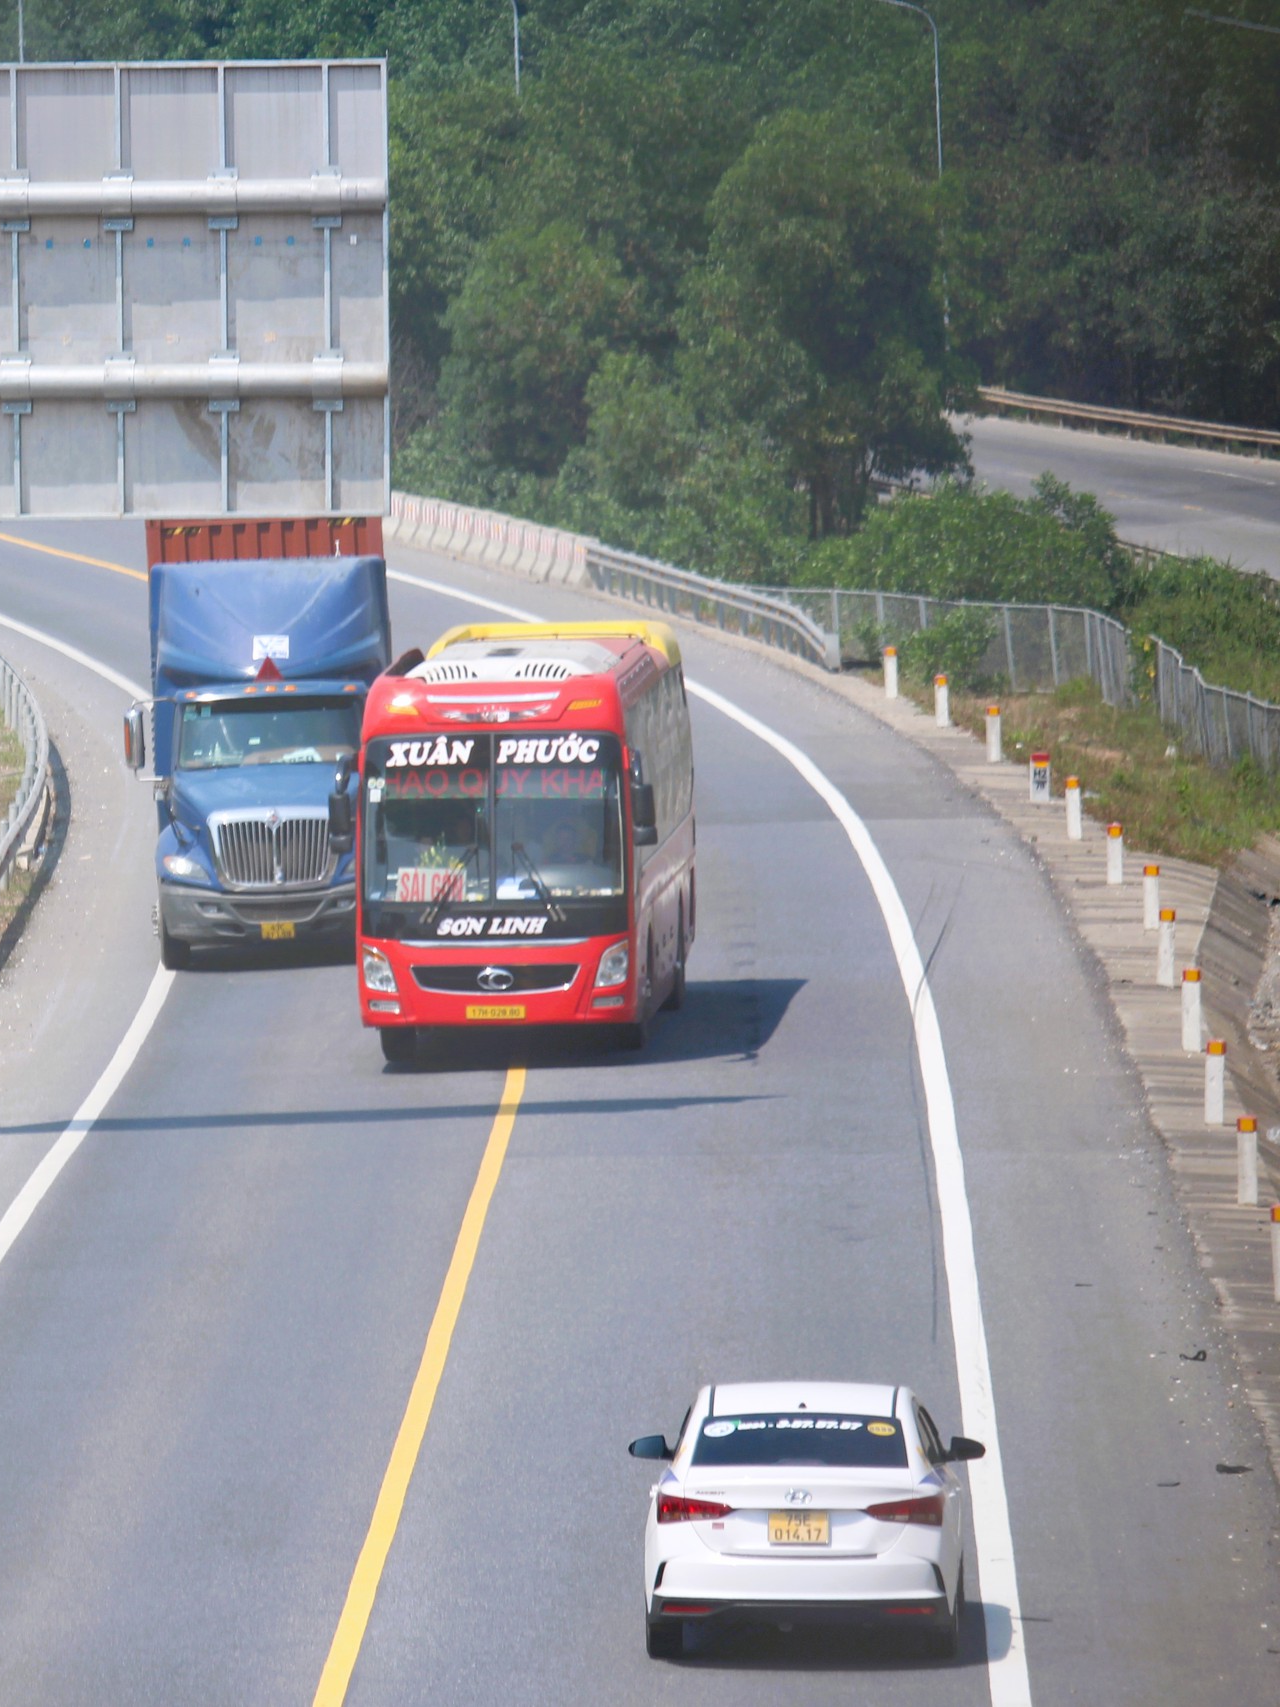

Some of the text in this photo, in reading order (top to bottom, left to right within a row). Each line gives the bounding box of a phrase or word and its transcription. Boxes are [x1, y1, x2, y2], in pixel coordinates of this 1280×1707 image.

[386, 733, 600, 767] XUÂN PHƯỚC
[437, 917, 548, 936] SƠN LINH
[774, 1527, 822, 1541] 014.17
